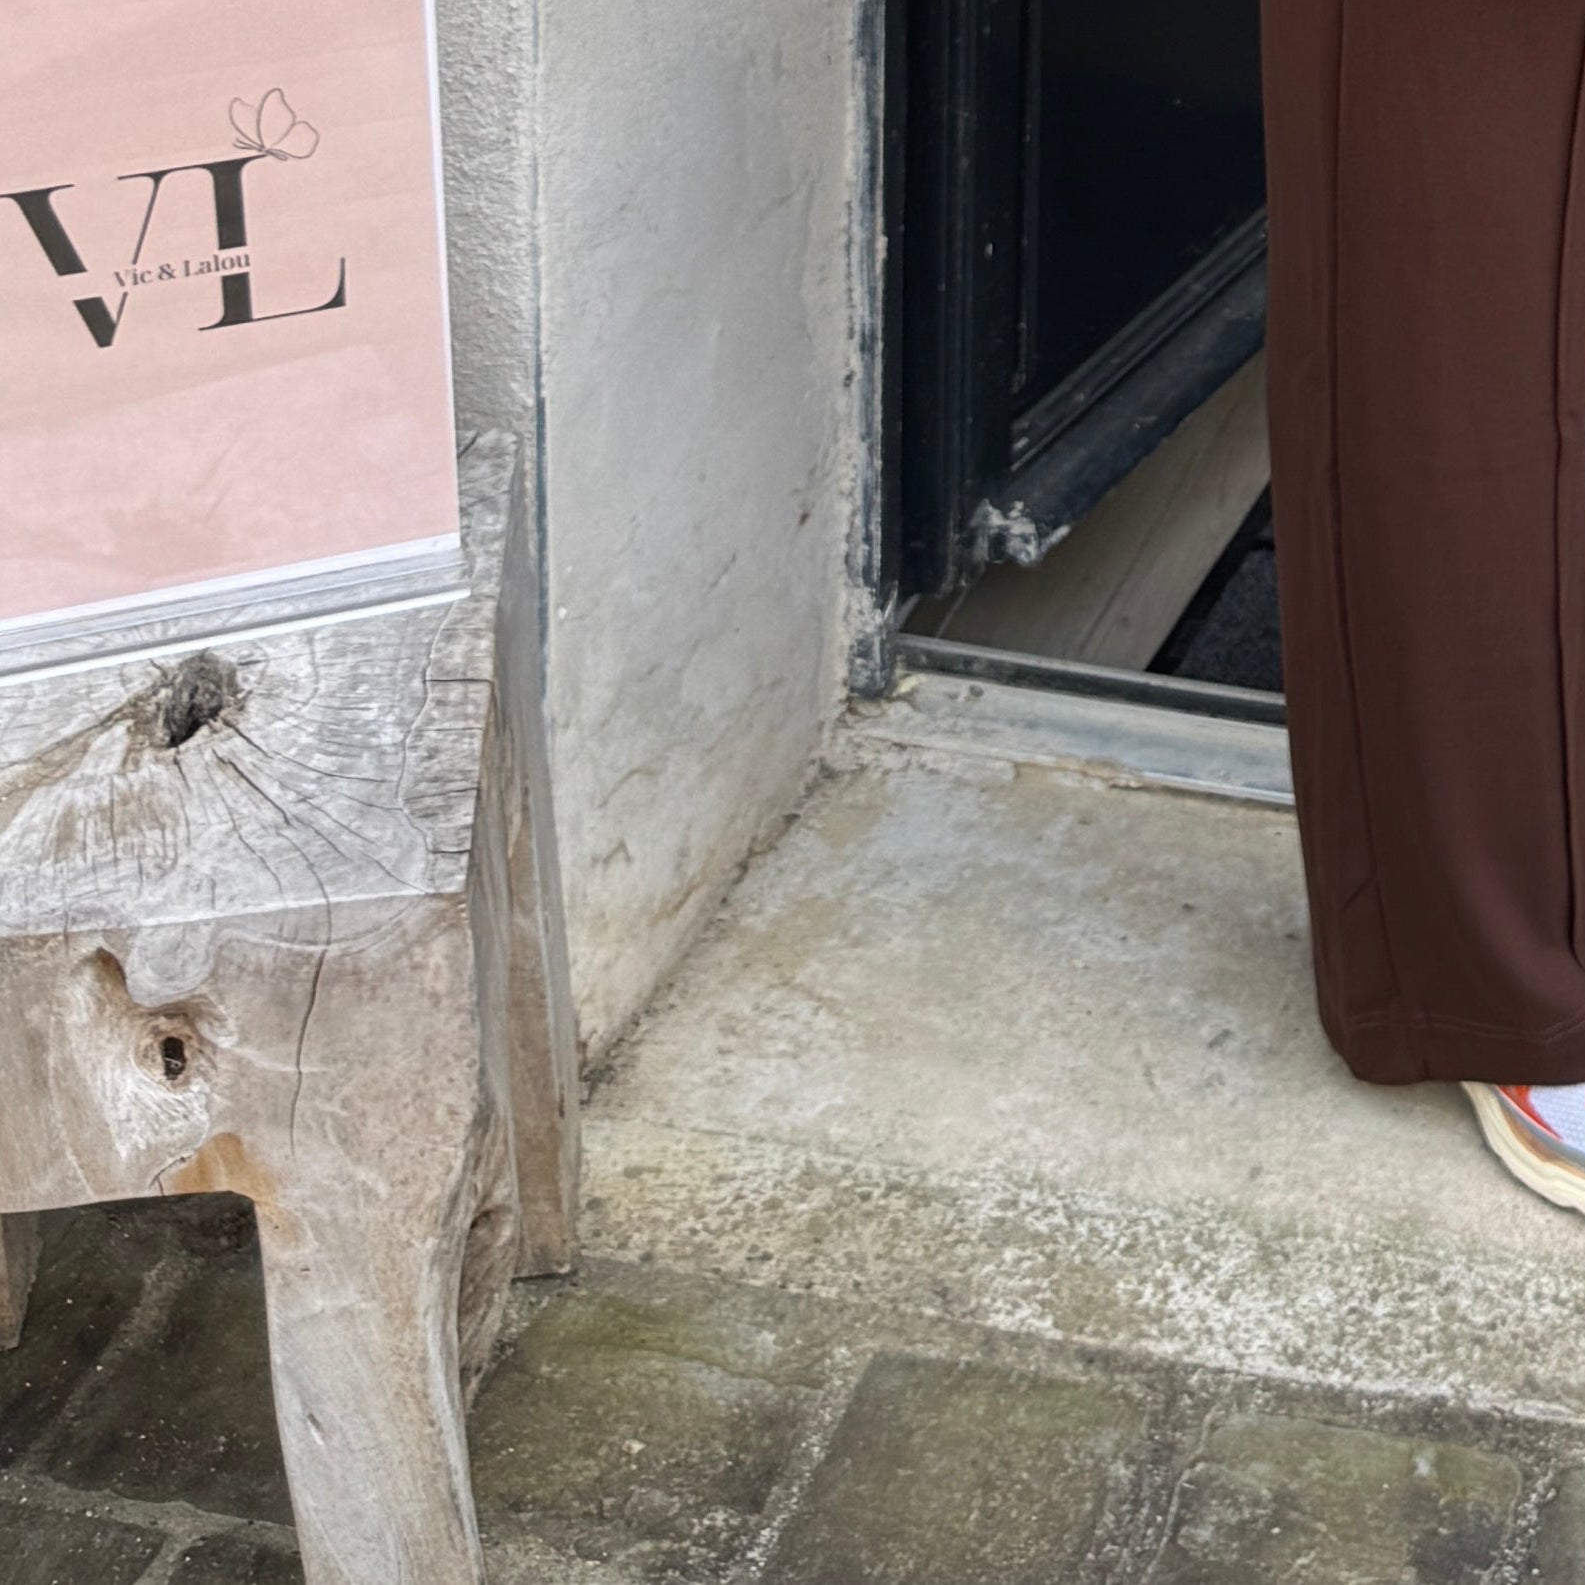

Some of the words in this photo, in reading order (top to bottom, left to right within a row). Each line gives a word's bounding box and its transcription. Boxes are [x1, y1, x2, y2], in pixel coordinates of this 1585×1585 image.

[0, 154, 347, 349] VL
[113, 266, 153, 287] Vic
[157, 263, 176, 281] &
[184, 253, 250, 278] Lalou
